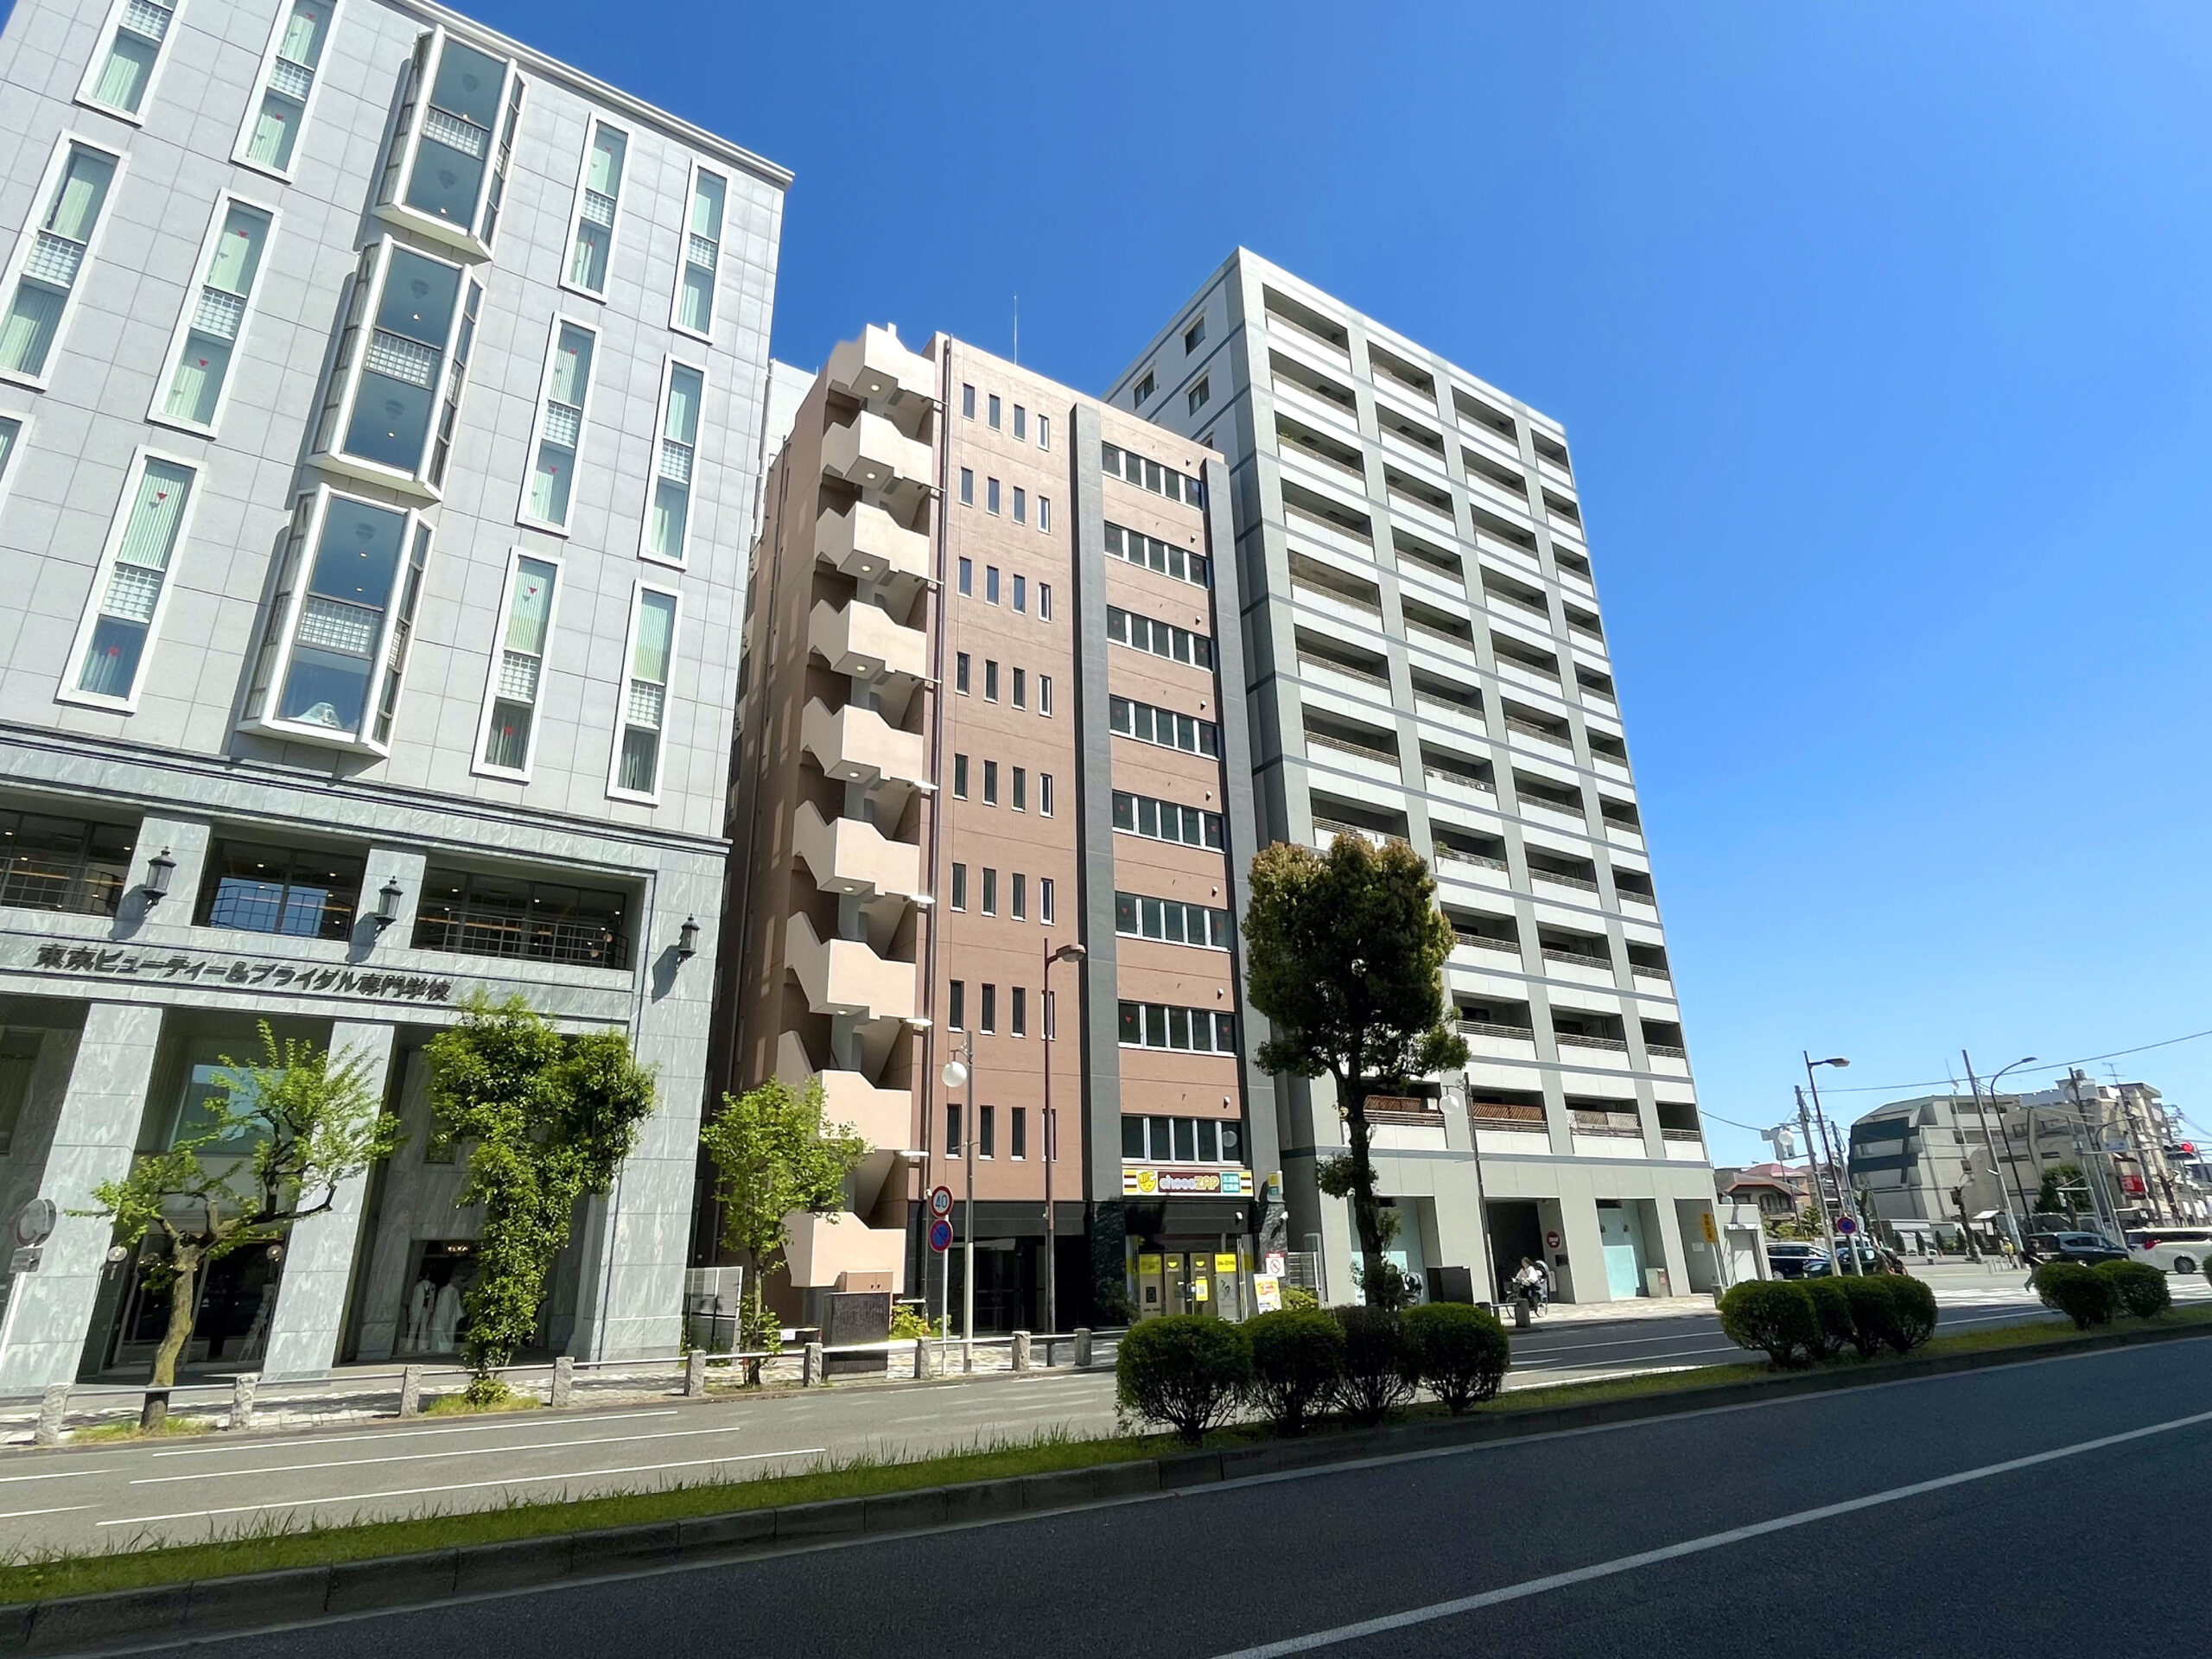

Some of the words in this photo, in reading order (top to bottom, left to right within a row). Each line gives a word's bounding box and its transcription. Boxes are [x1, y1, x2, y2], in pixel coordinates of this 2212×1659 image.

[33, 943, 451, 1002] 東京ビューティー&ブライダル専門学校
[1159, 1173, 1220, 1191] chocoZAP
[935, 1194, 948, 1208] 40
